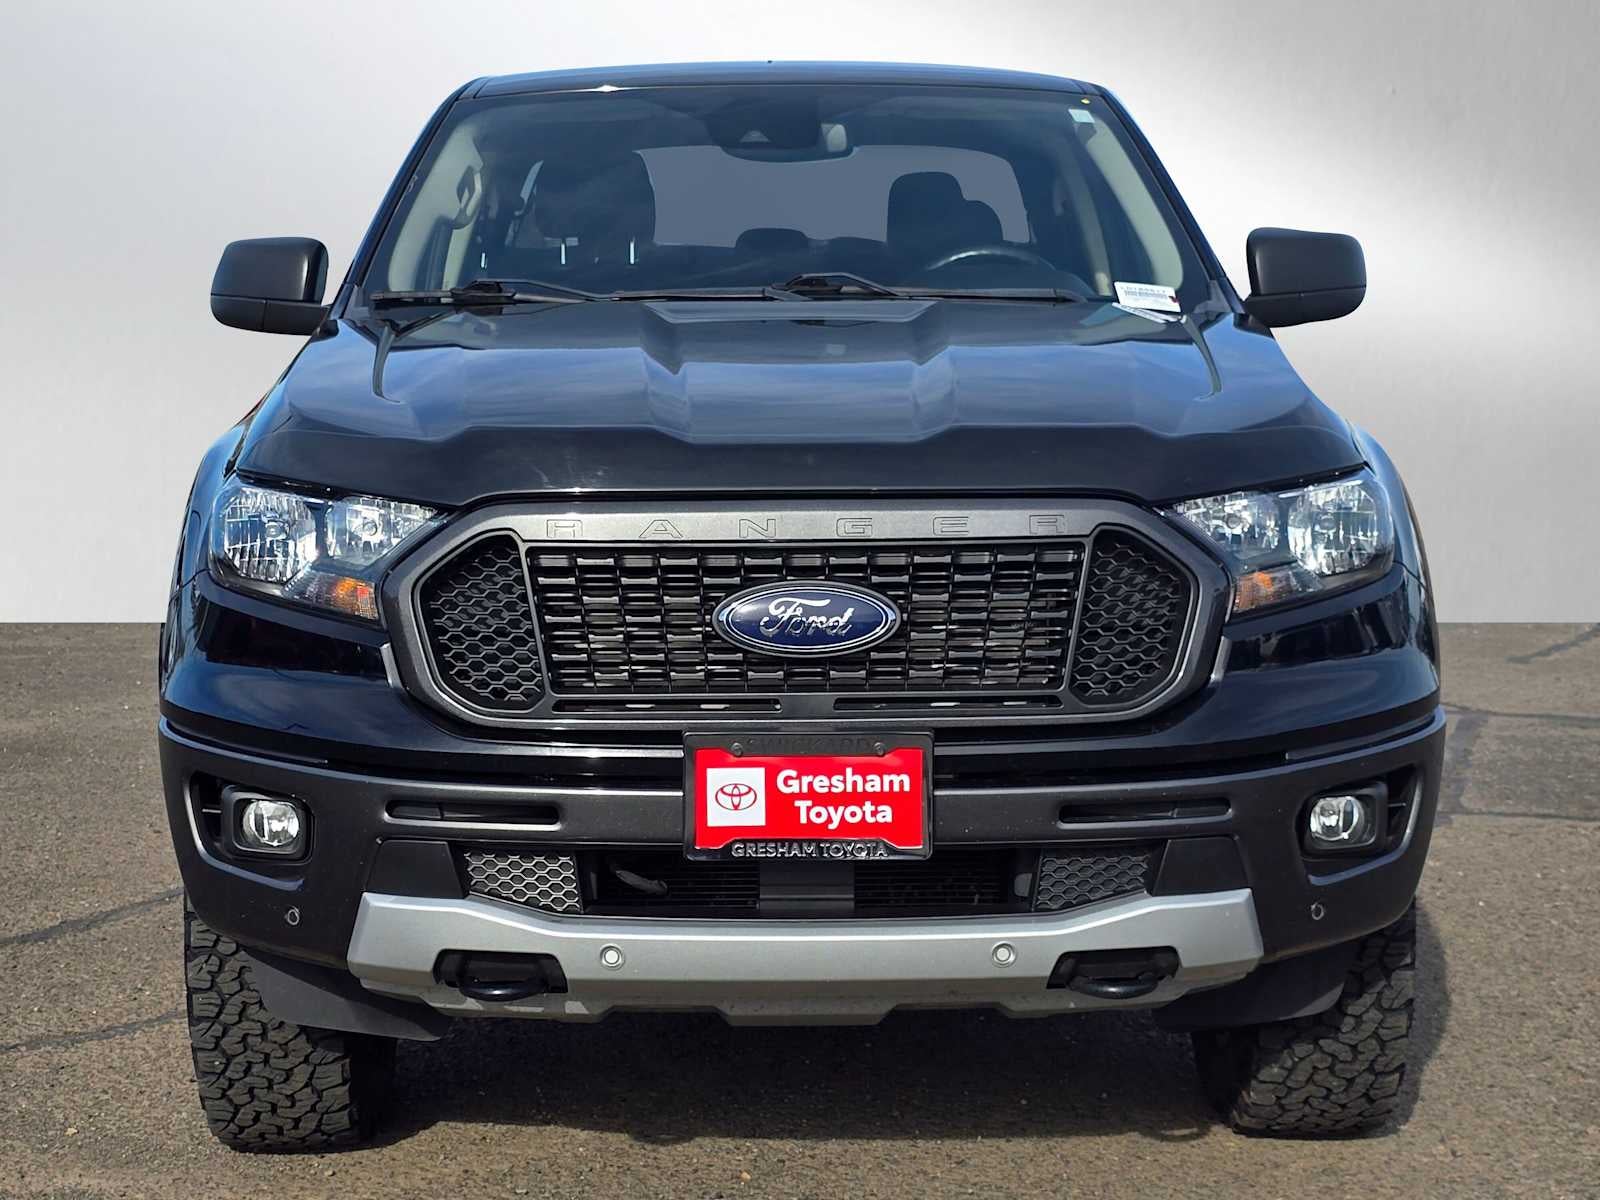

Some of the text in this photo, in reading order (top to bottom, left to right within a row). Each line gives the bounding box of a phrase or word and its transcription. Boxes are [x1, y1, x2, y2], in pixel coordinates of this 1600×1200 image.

[546, 514, 1065, 539] RANGER
[759, 597, 855, 637] Ford
[776, 767, 911, 794] Gresham
[794, 800, 893, 830] Toyota
[731, 842, 888, 858] GRESHAM TOYOTA
